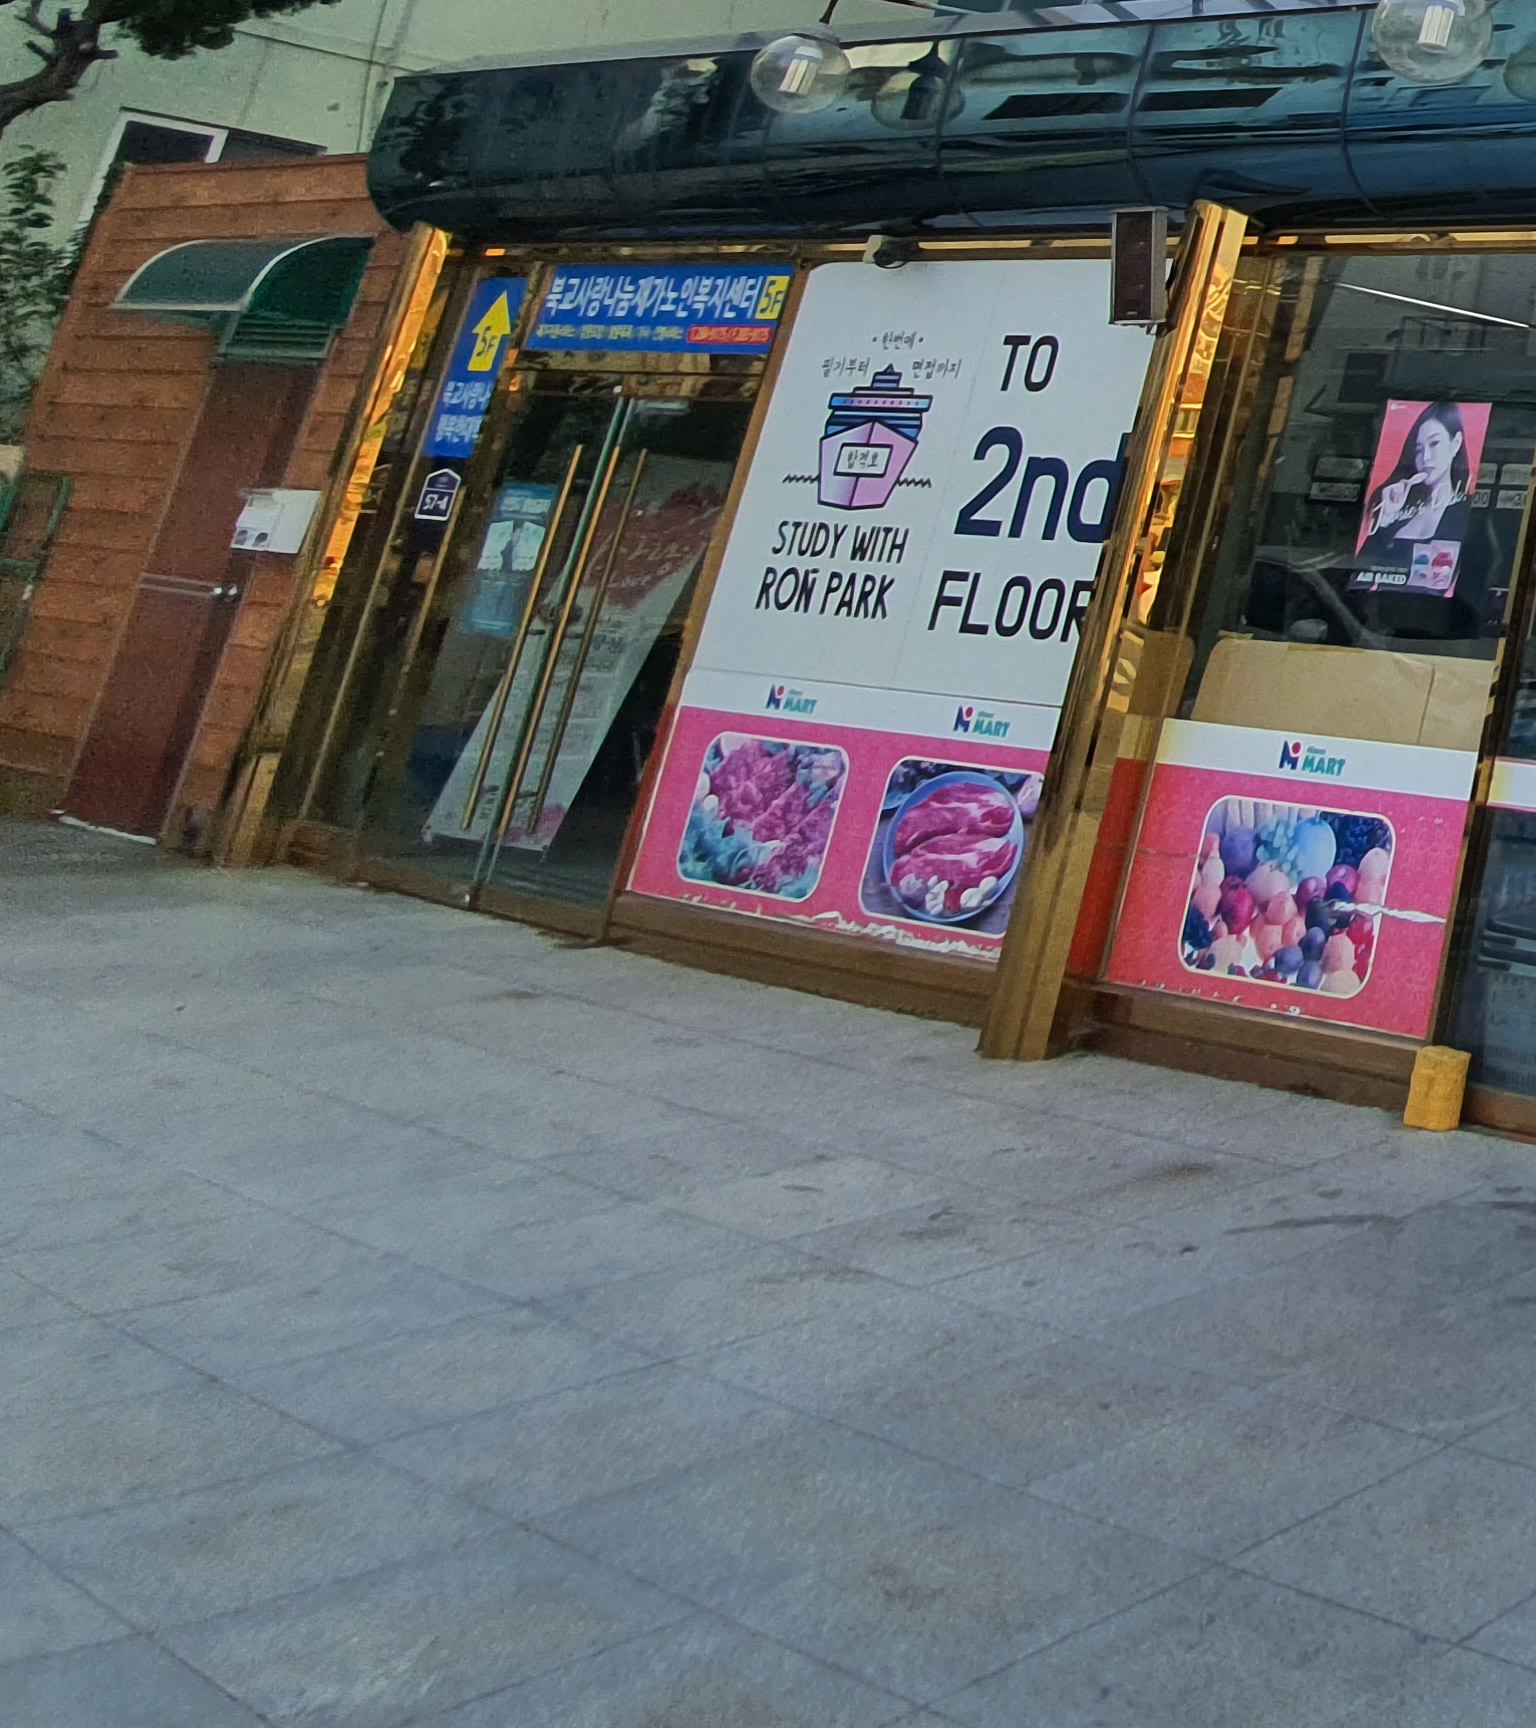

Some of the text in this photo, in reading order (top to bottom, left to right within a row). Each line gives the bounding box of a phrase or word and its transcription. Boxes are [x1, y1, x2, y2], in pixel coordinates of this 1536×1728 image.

[1000, 334, 1060, 393] TO
[953, 425, 1130, 544] 2nd
[771, 520, 910, 564] STUDY WITH
[818, 570, 896, 620] PARK
[1301, 755, 1347, 776] MART
